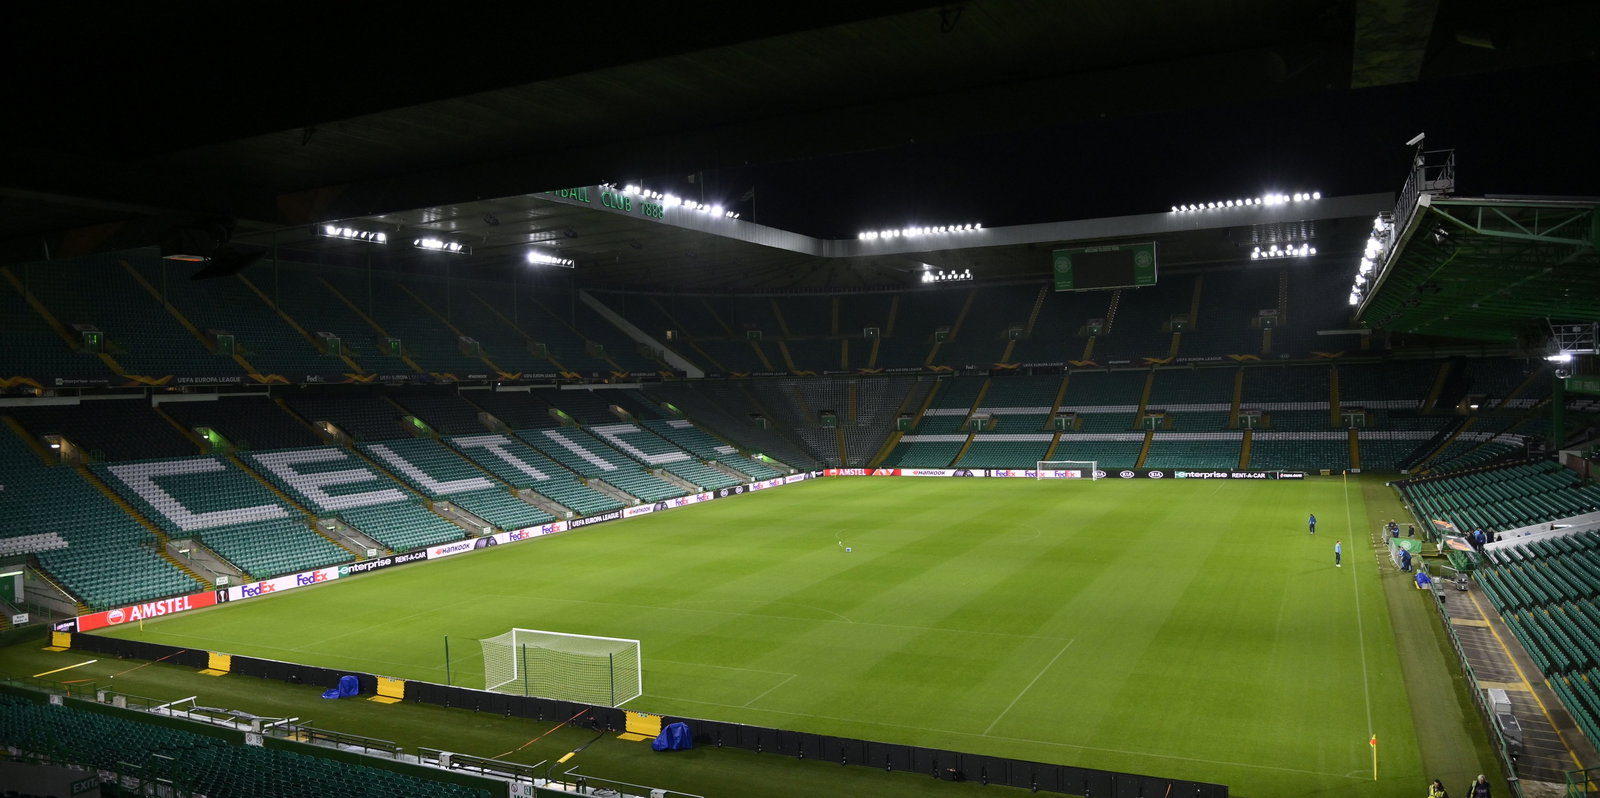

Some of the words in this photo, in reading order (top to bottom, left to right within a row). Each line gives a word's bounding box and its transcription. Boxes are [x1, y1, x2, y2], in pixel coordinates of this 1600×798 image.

[601, 191, 633, 212] CLUB
[640, 200, 665, 220] 1888
[107, 424, 691, 532] CELTIC
[838, 468, 867, 476] AMSTEL
[1176, 471, 1228, 479] enterprise
[585, 516, 603, 525] EUROPA
[602, 512, 619, 521] LEAGUE
[509, 529, 529, 541] FedEx
[542, 522, 560, 534] FedEx
[338, 558, 391, 574] enterprise
[395, 552, 427, 563] RENT-A-CAR
[297, 570, 328, 586] FedEx
[241, 581, 275, 597] FedEx
[129, 596, 192, 621] AMSTEL
[73, 778, 96, 794] EXIT
